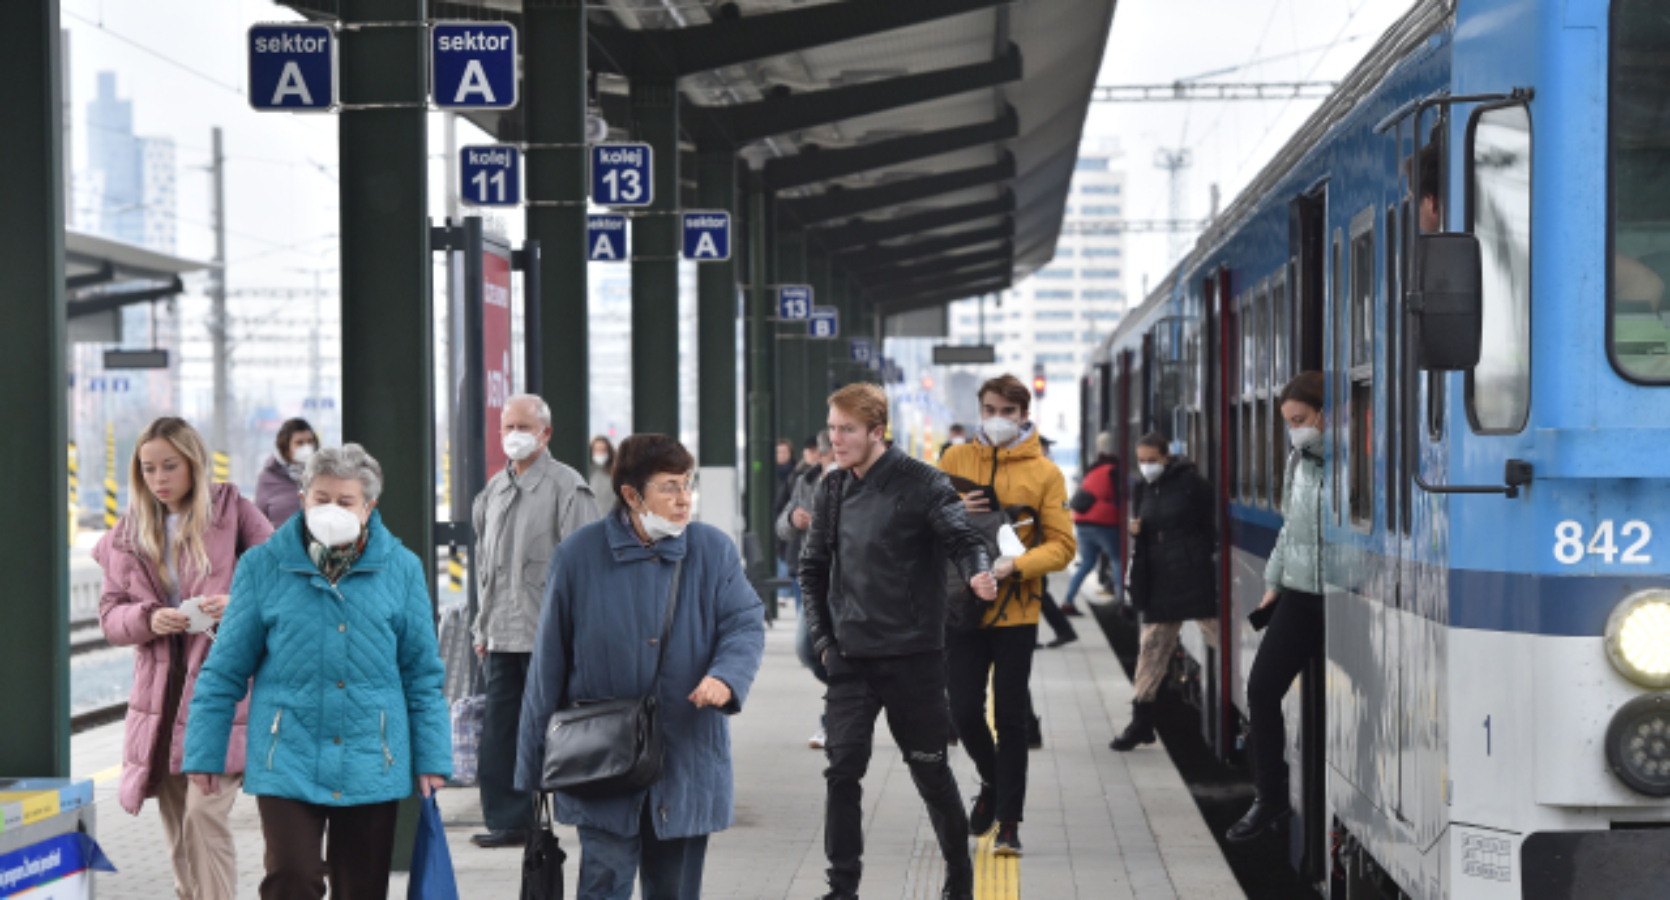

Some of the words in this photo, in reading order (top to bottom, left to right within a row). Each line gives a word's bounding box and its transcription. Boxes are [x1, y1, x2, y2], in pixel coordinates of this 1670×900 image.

[256, 34, 327, 53] sektor
[438, 32, 510, 52] sektor
[271, 61, 313, 104] A
[454, 60, 496, 103] A
[469, 150, 511, 168] kolej
[600, 148, 643, 167] kolej
[471, 169, 506, 202] 11
[602, 168, 643, 201] 13
[686, 217, 727, 228] sektor
[592, 233, 616, 259] A
[694, 231, 718, 257] A
[785, 299, 806, 318] 13
[815, 320, 830, 337] B
[1553, 519, 1652, 564] 842
